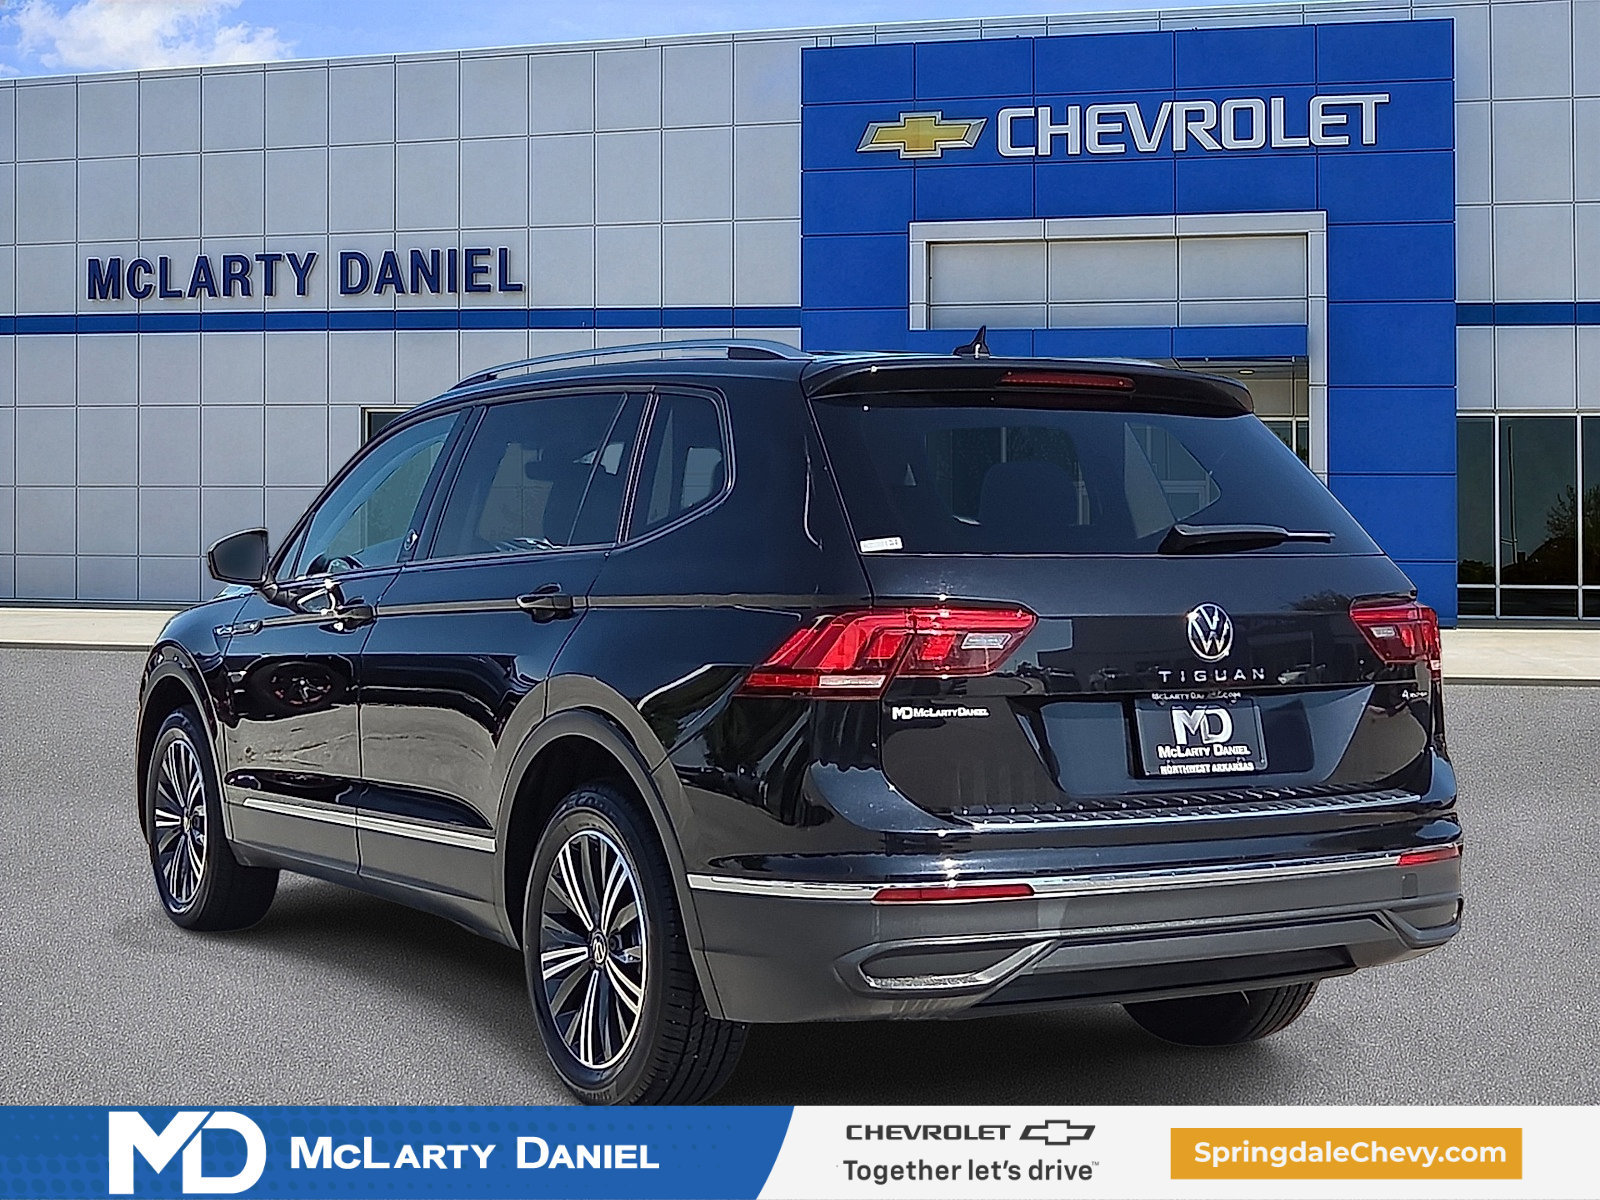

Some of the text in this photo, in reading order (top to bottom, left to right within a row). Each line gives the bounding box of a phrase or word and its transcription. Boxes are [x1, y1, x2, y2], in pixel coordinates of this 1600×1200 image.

[996, 93, 1390, 157] CHEVROLET
[338, 247, 524, 295] DANIEL
[1158, 667, 1265, 683] TIGUAN
[892, 706, 913, 720] MD
[1171, 706, 1233, 745] MD
[1213, 743, 1251, 756] DANIEL
[1160, 761, 1255, 775] NORTHWEST ARKANSAS
